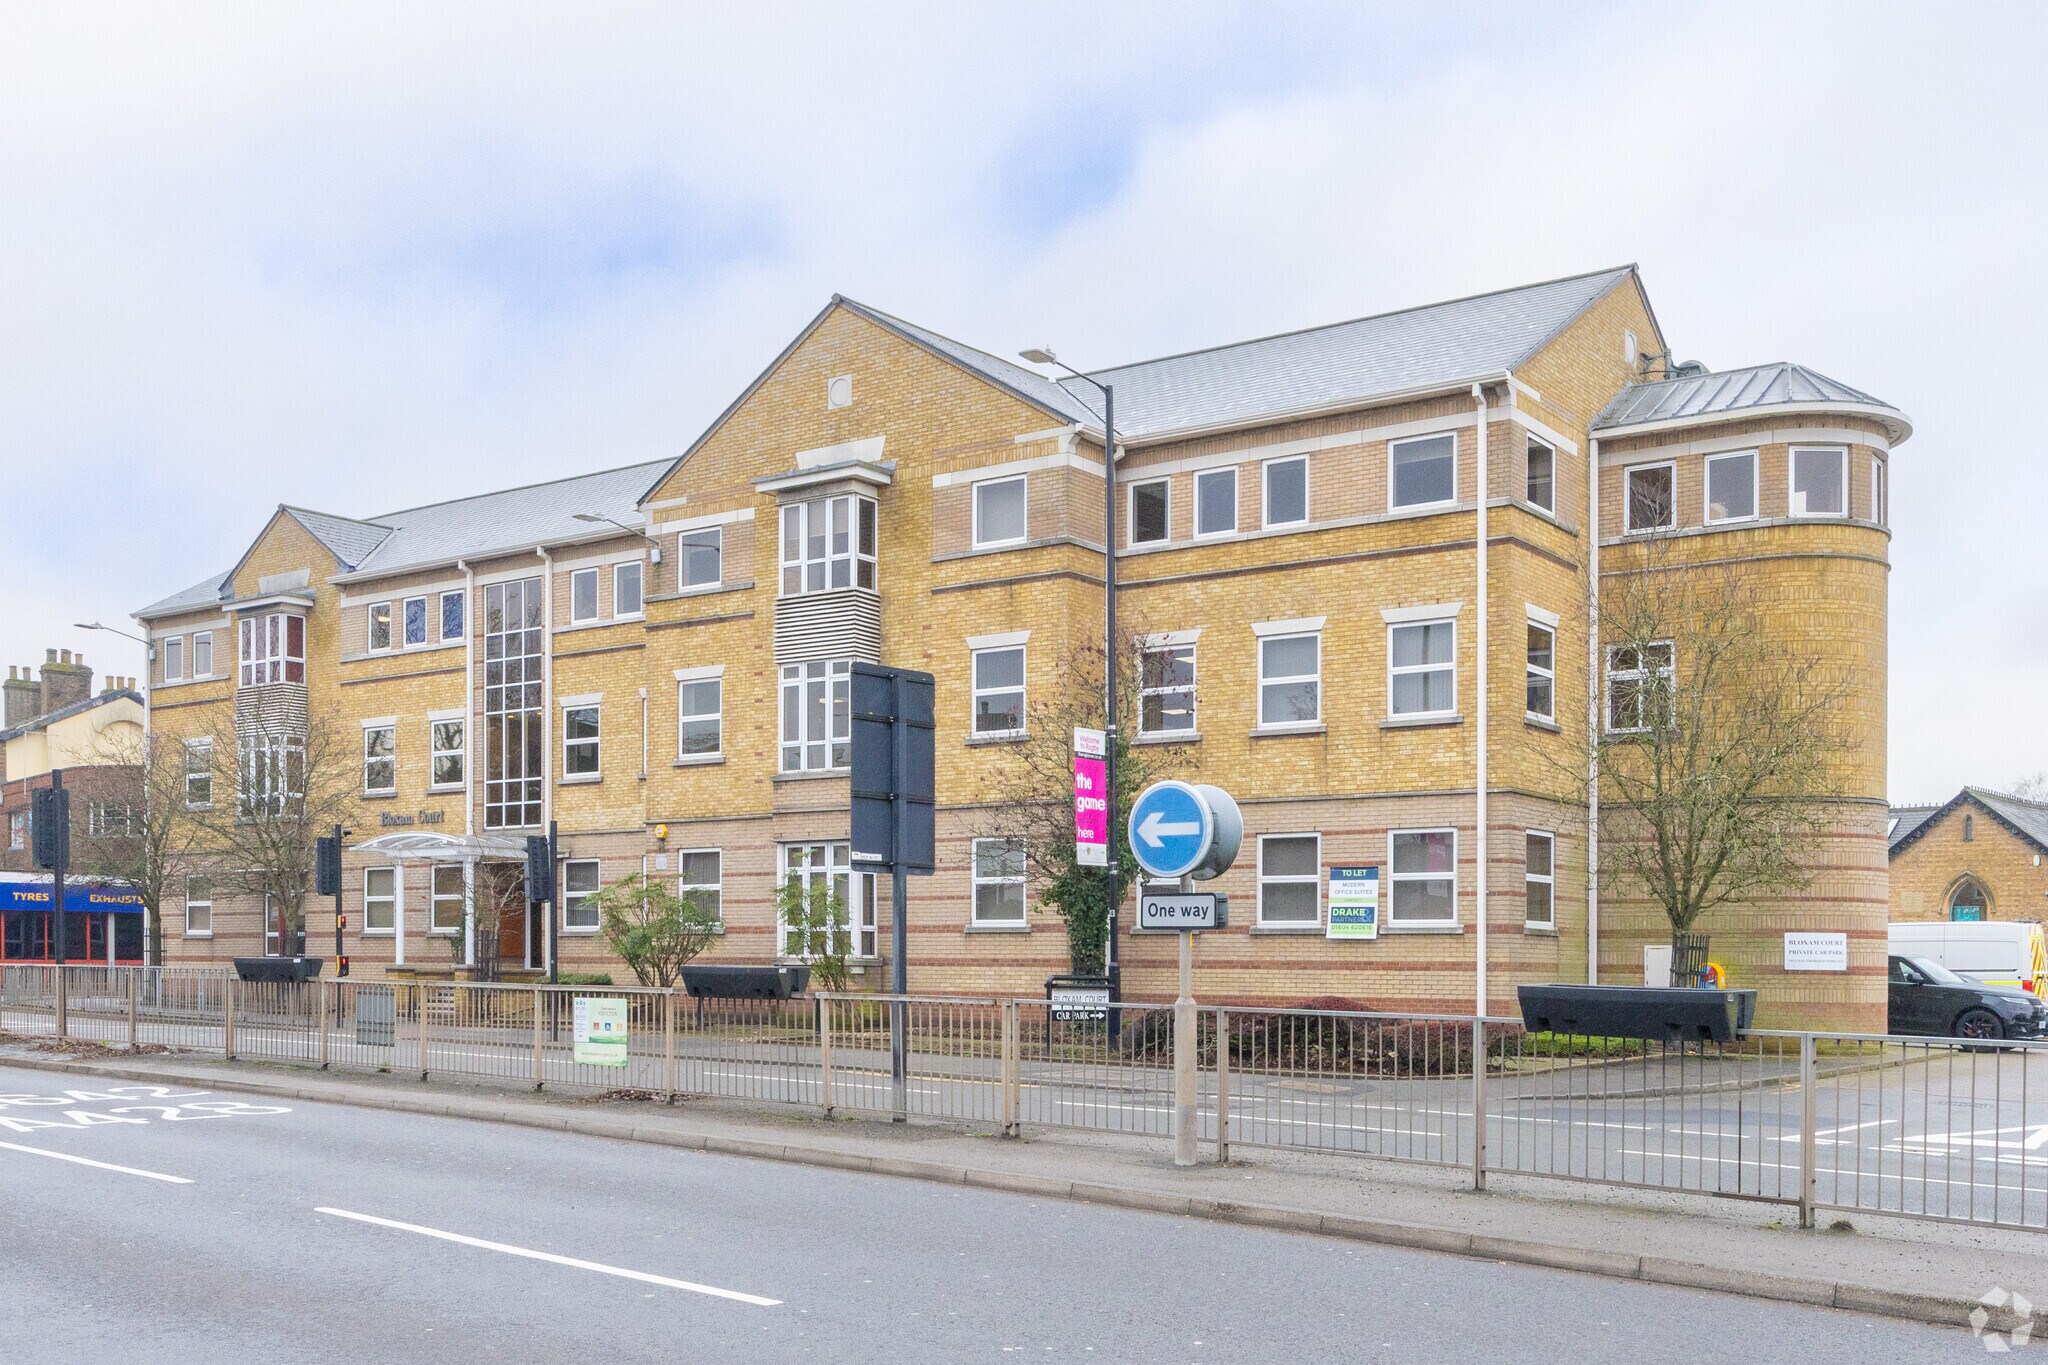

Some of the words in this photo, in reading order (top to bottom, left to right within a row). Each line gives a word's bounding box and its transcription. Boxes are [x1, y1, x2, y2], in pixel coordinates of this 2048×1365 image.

[1086, 743, 1099, 753] Rugby
[1076, 773, 1092, 790] the
[1077, 796, 1106, 813] game
[419, 809, 445, 825] Court
[1077, 826, 1094, 839] here
[1342, 869, 1352, 877] TO
[1353, 869, 1367, 877] LET
[13, 892, 49, 901] TYRES
[89, 894, 145, 904] EXHAUSTS
[1148, 903, 1175, 917] One
[1181, 906, 1209, 920] way
[1332, 908, 1366, 916] DRAKE
[1056, 1011, 1070, 1020] CAR
[1073, 1011, 1089, 1020] PARK
[0, 1086, 212, 1109] 642
